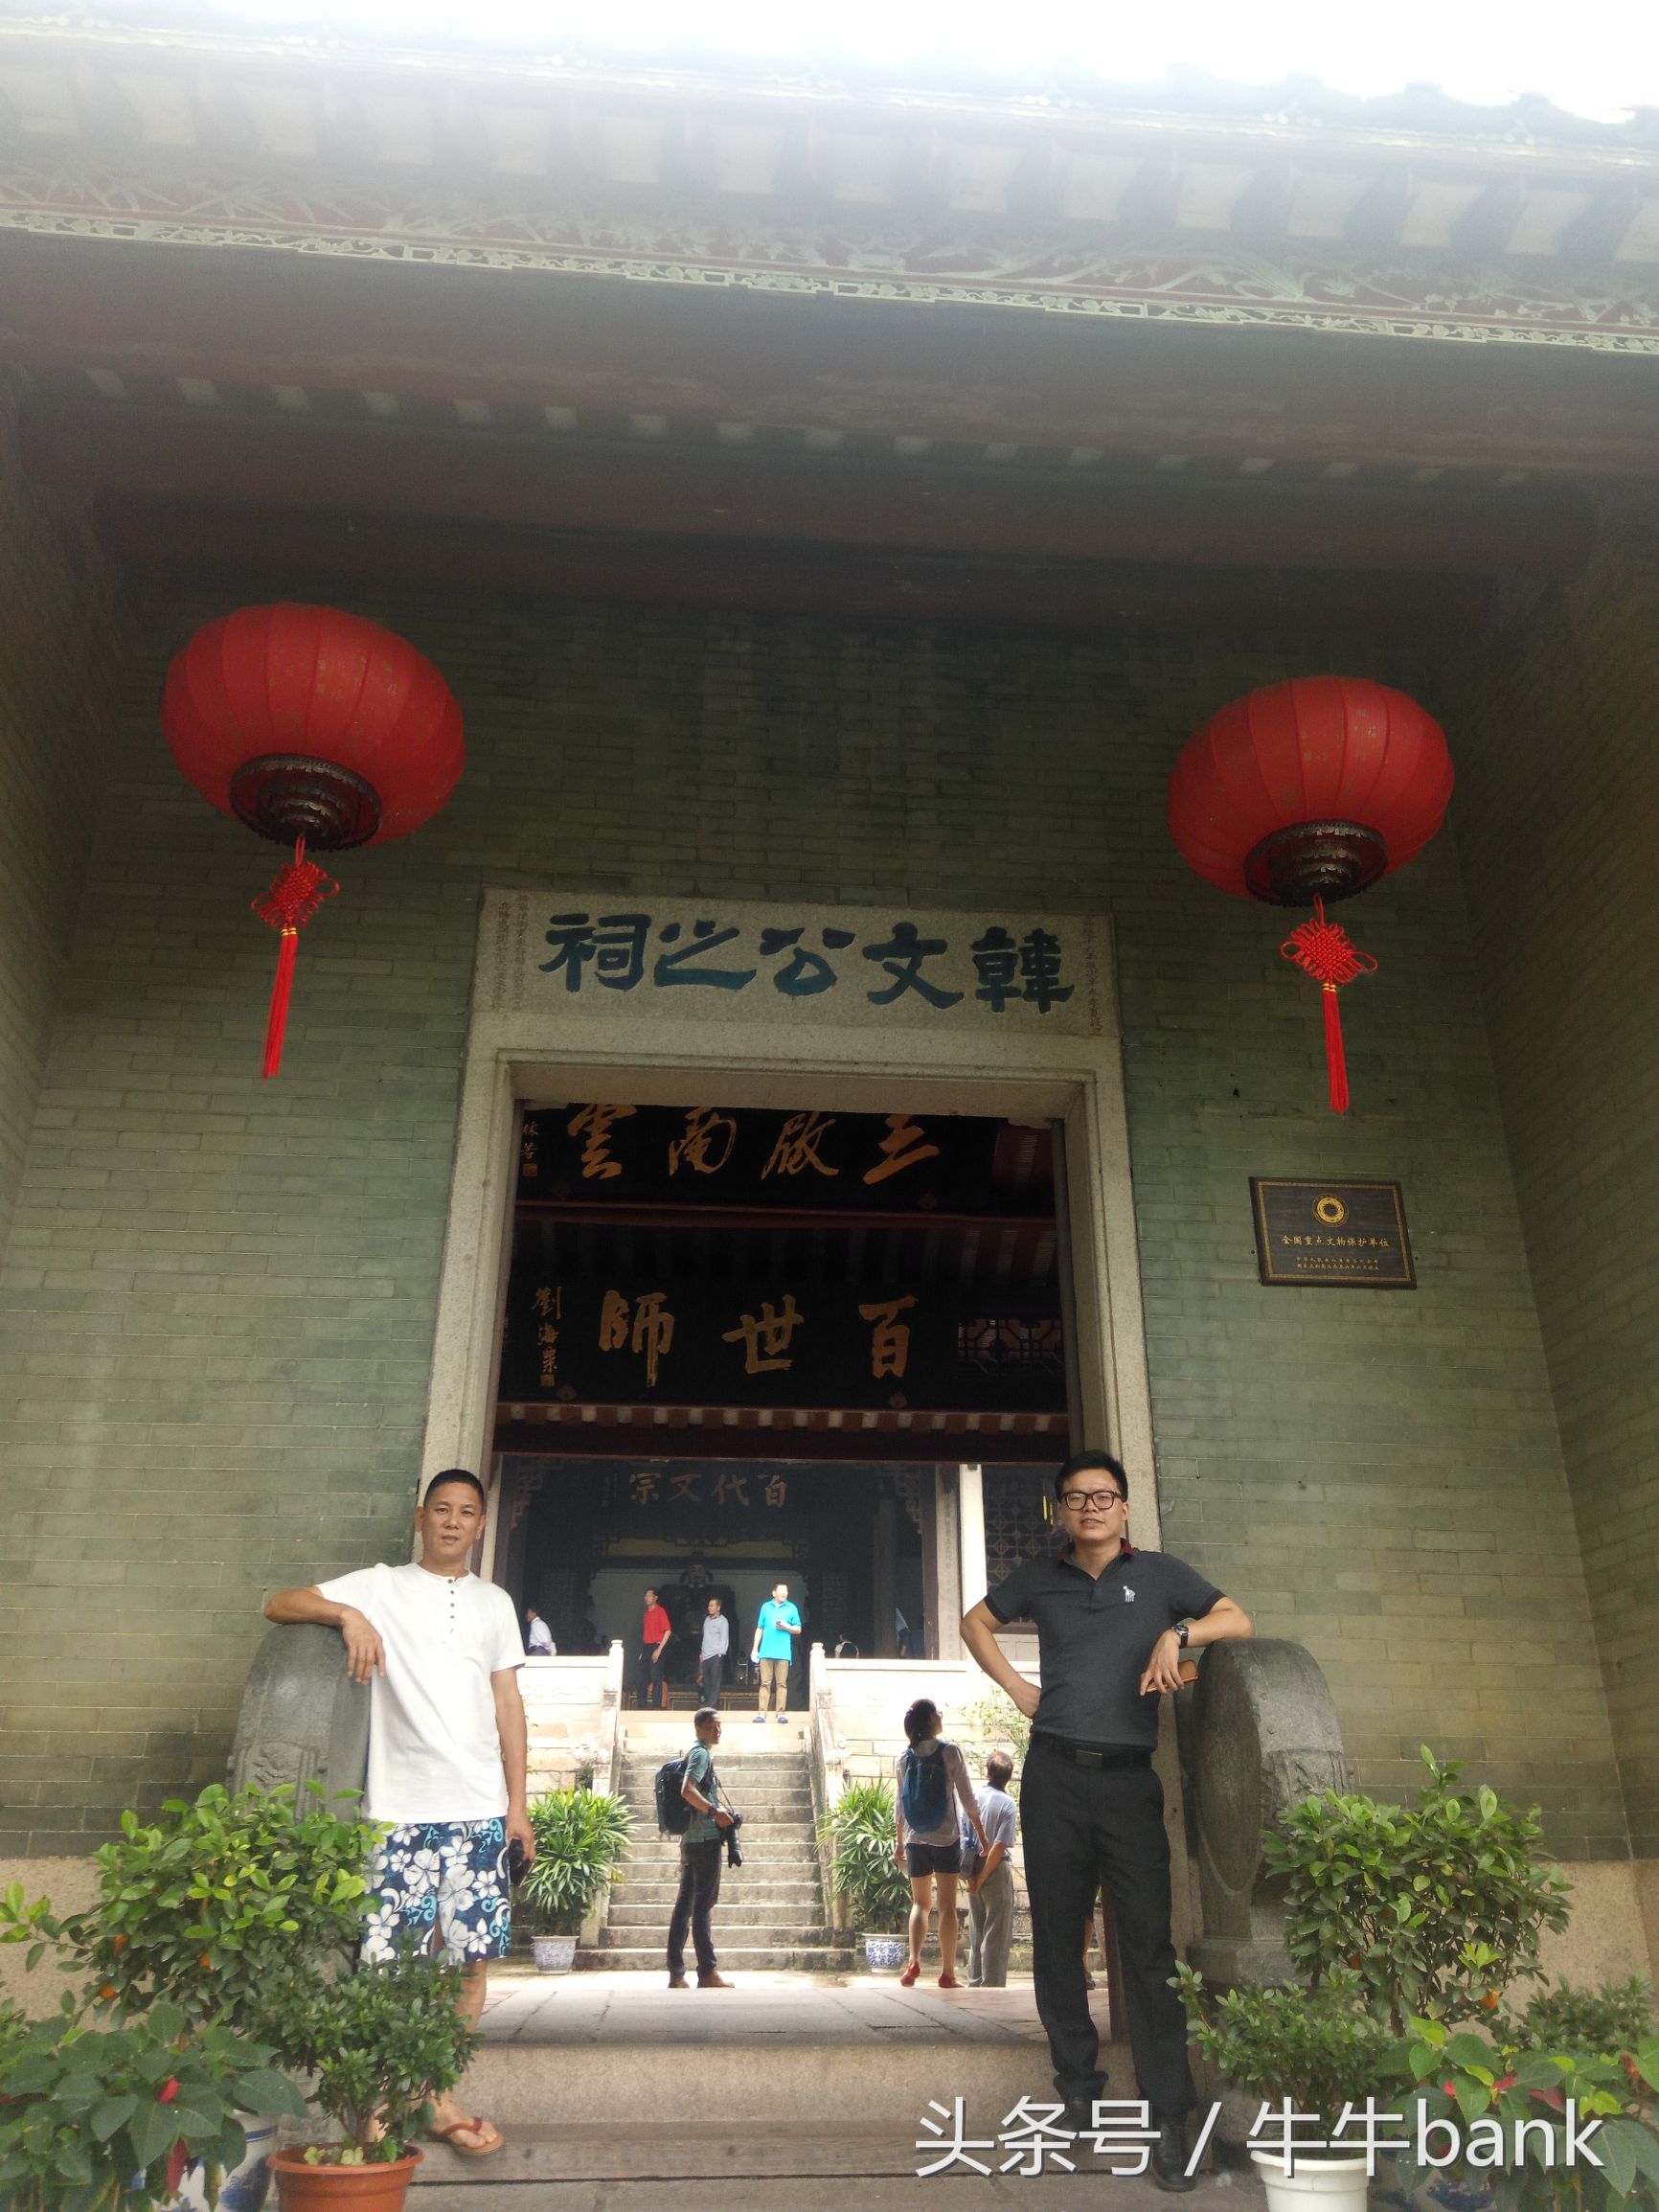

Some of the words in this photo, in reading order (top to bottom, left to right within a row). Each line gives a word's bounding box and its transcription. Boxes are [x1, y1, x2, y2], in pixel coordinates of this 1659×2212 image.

[1281, 1235, 1391, 1248] 全国重点文物保护单位
